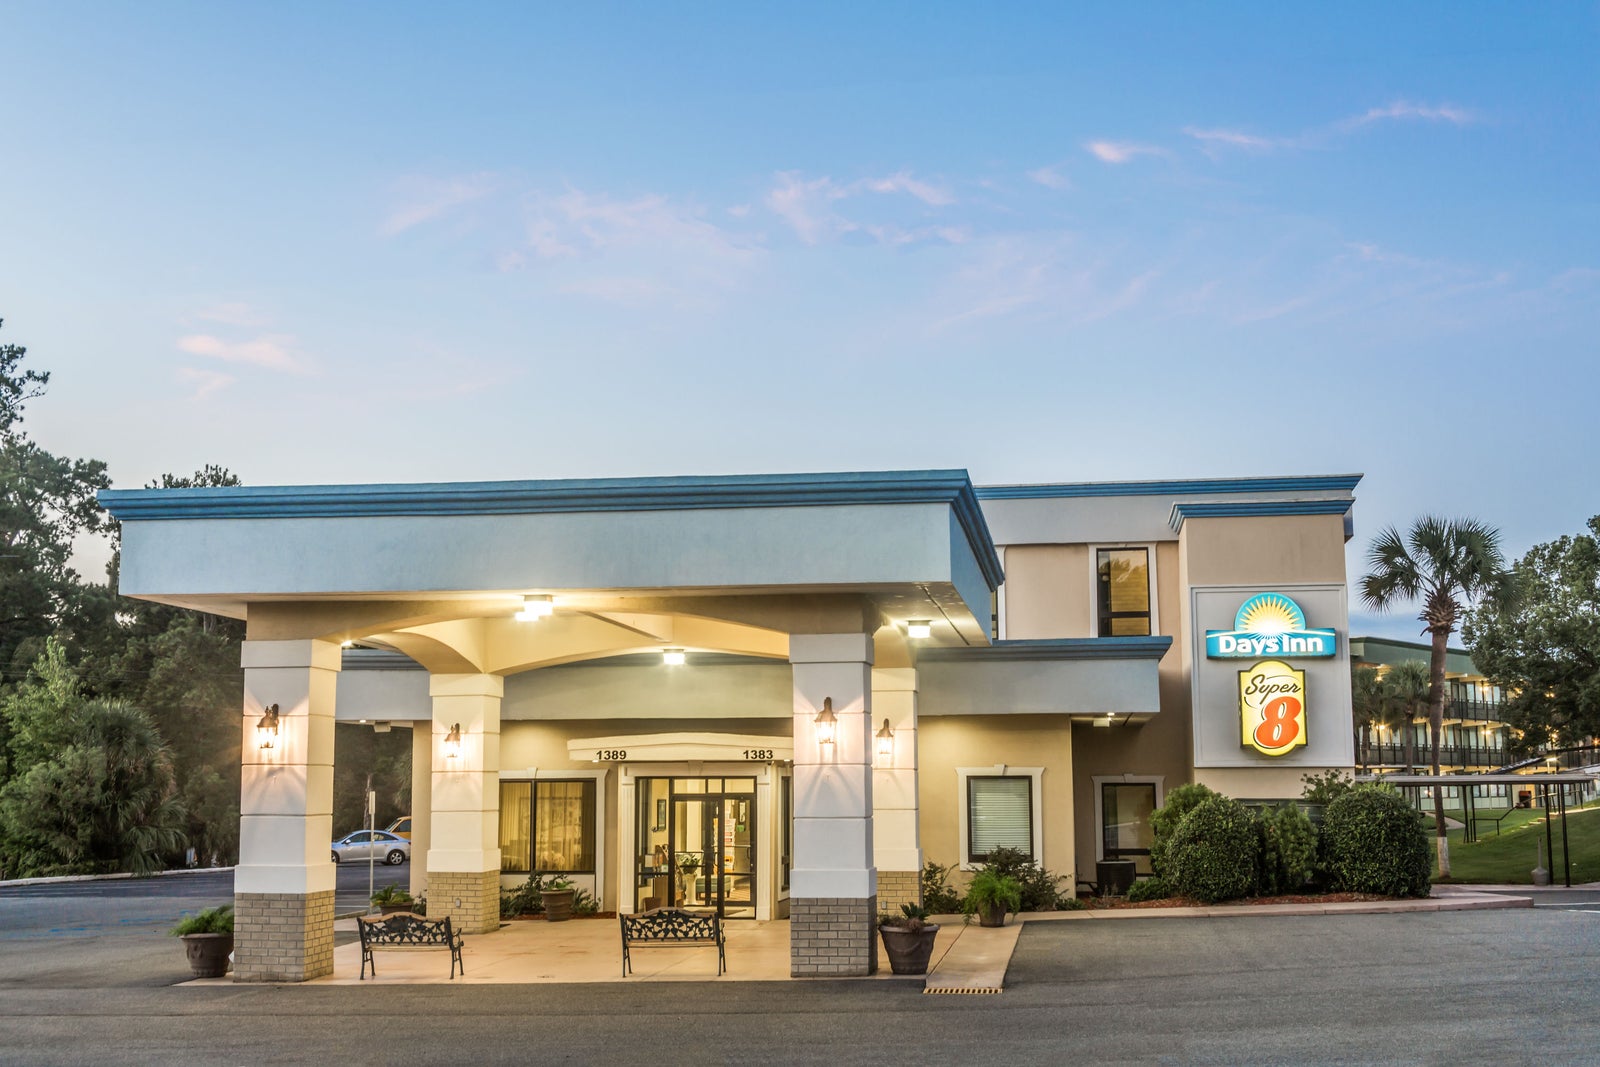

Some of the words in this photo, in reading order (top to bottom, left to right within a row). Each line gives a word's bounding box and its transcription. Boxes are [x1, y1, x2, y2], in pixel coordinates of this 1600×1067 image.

[1219, 636, 1278, 655] Days
[1283, 636, 1323, 652] Inn
[1245, 674, 1301, 704] Super
[1254, 696, 1301, 749] 8
[596, 750, 627, 760] 1389
[743, 750, 773, 760] 1383
